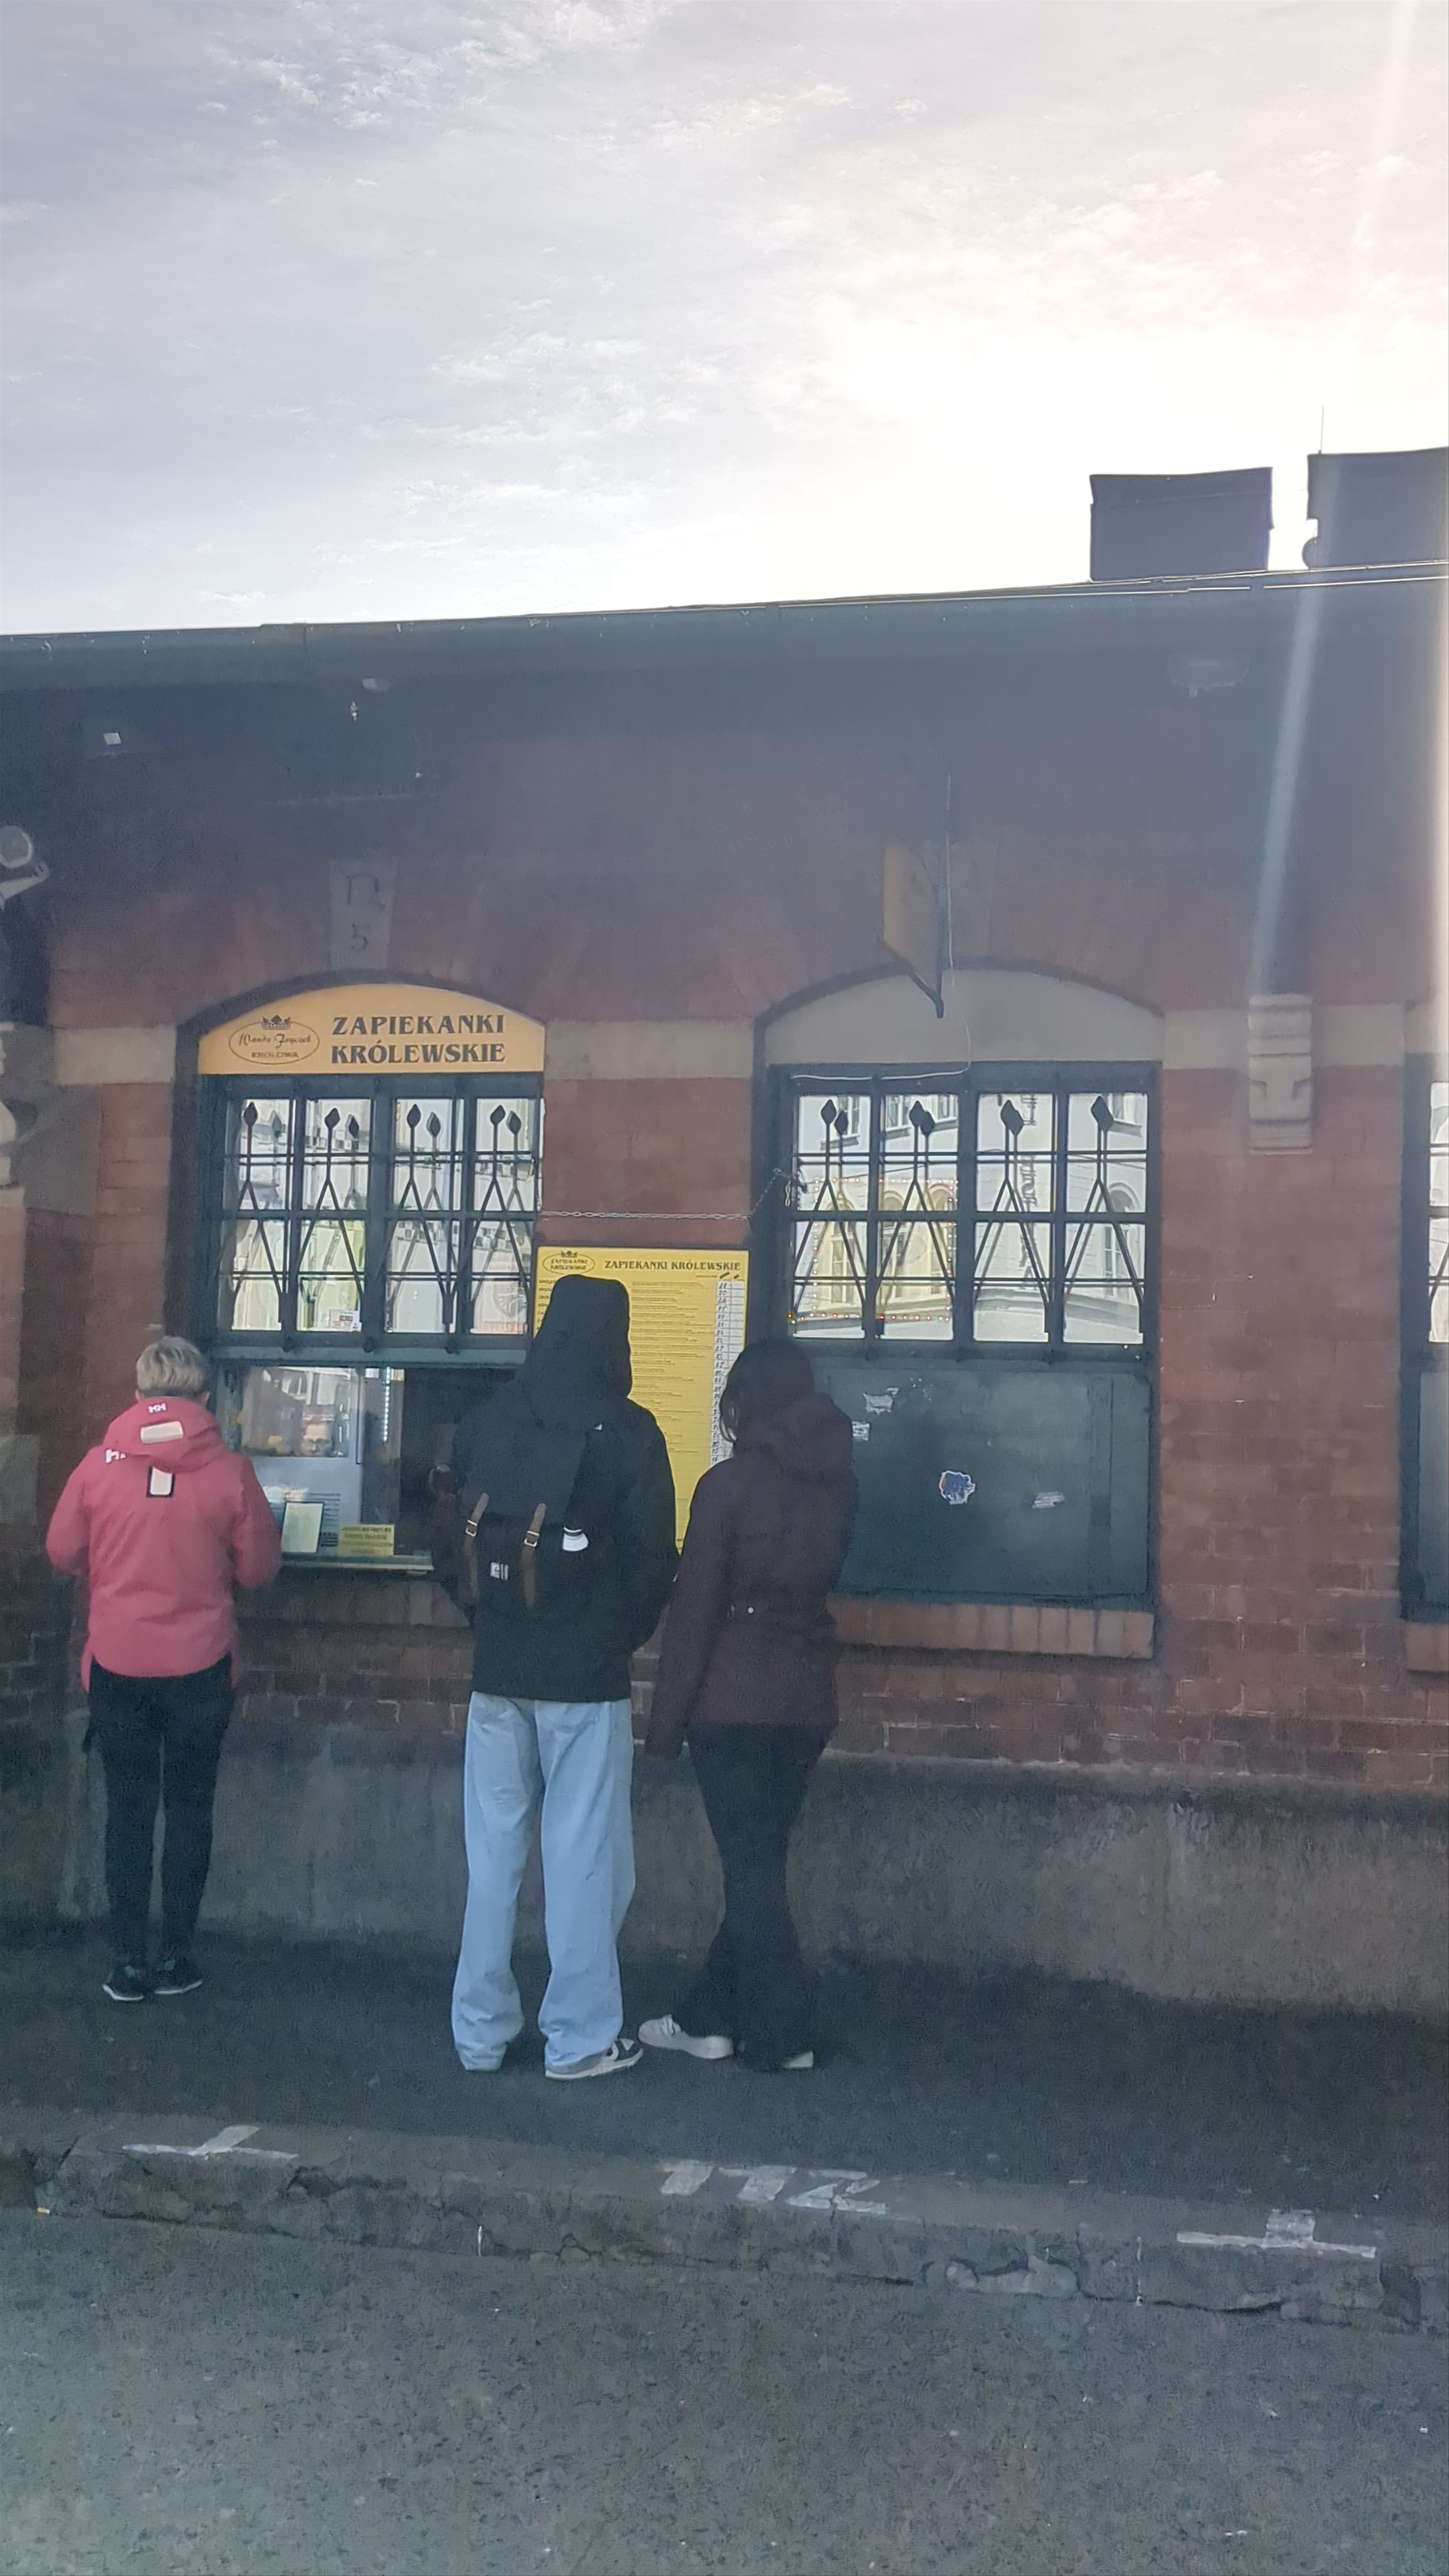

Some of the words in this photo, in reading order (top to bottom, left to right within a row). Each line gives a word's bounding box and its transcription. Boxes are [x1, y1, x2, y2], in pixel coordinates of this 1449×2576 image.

[332, 1015, 504, 1035] ZAPIEKANKI
[331, 1040, 506, 1064] KRÓLEWSKIE
[604, 1260, 668, 1270] ZAPIEKANKI
[671, 1259, 741, 1271] KRÓLEWSKIE
